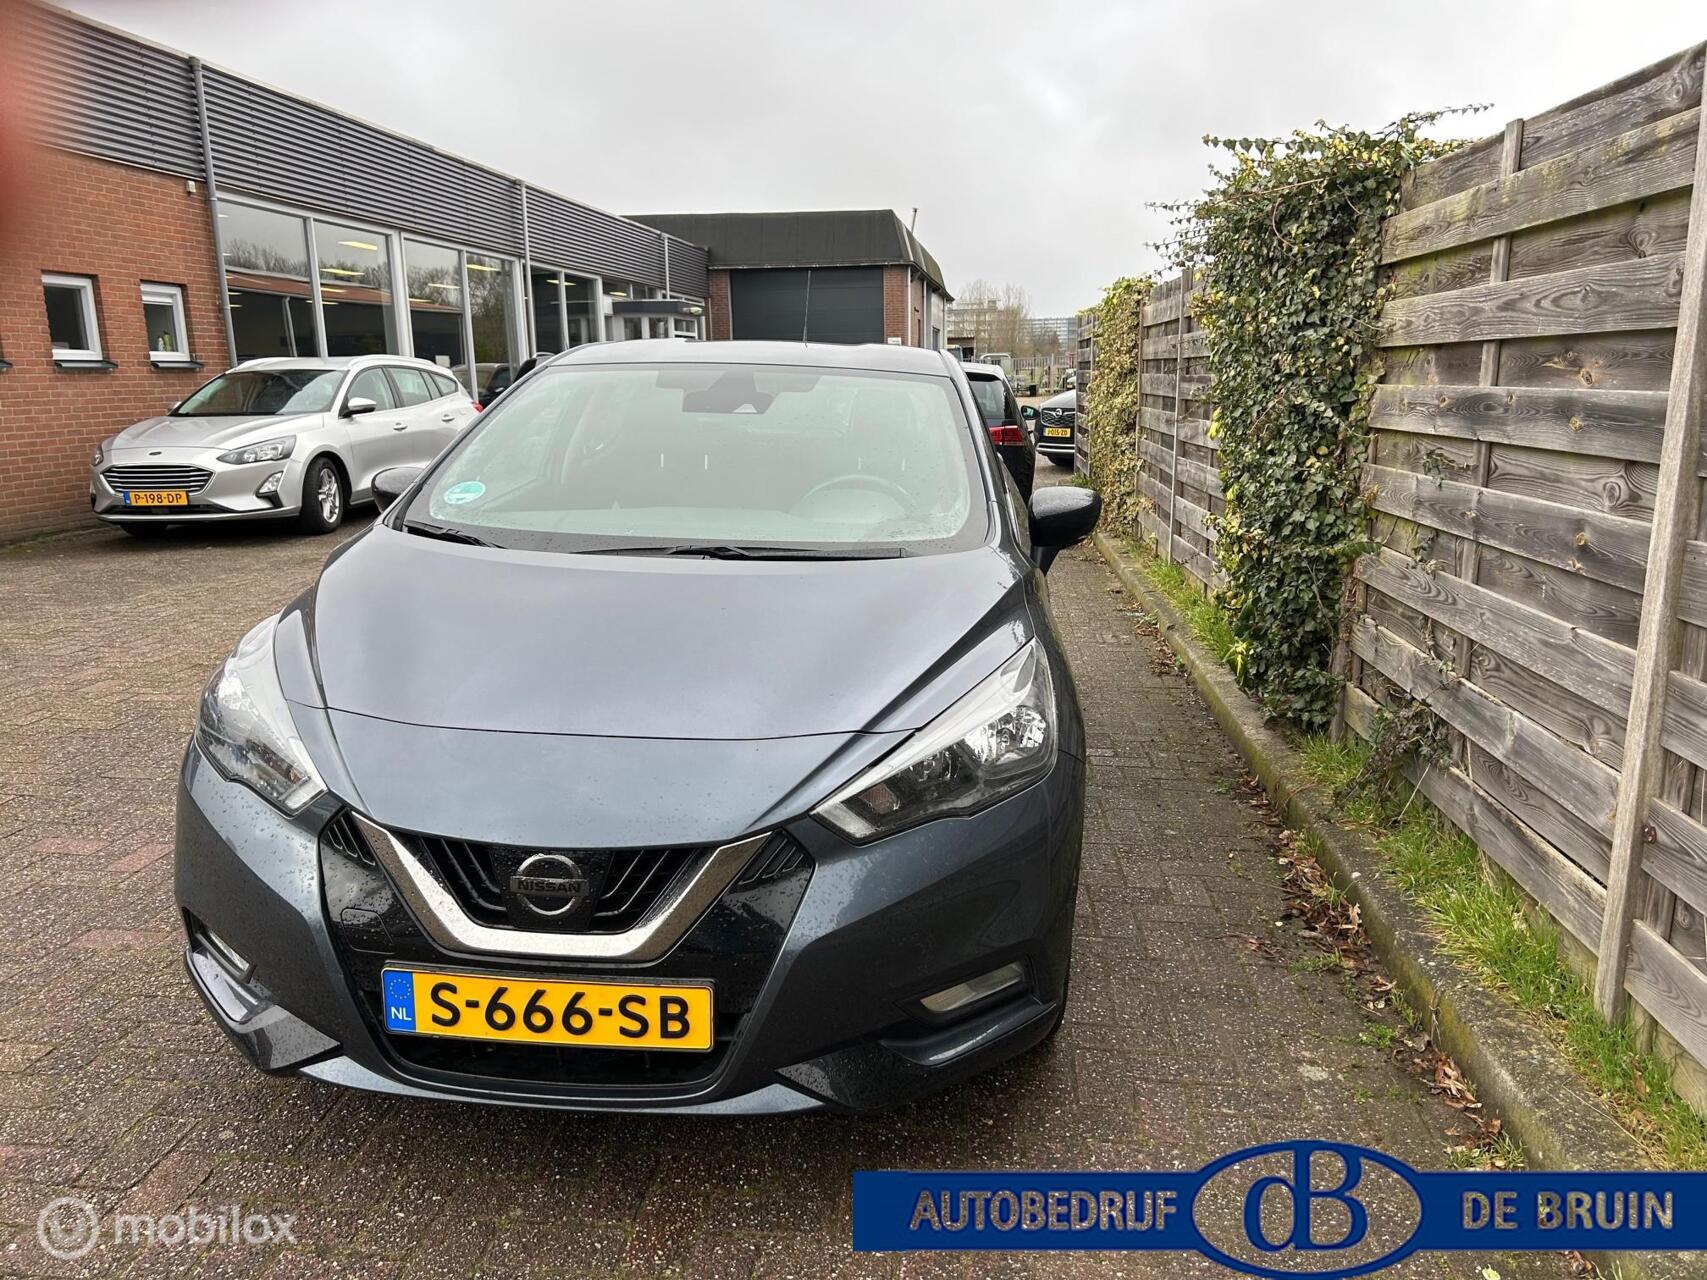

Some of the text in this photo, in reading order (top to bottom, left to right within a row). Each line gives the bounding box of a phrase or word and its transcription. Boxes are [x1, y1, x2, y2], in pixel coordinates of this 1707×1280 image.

[134, 493, 182, 504] P-198-DP
[518, 879, 581, 893] NISSAN
[391, 982, 691, 1039] NL S-666-SB
